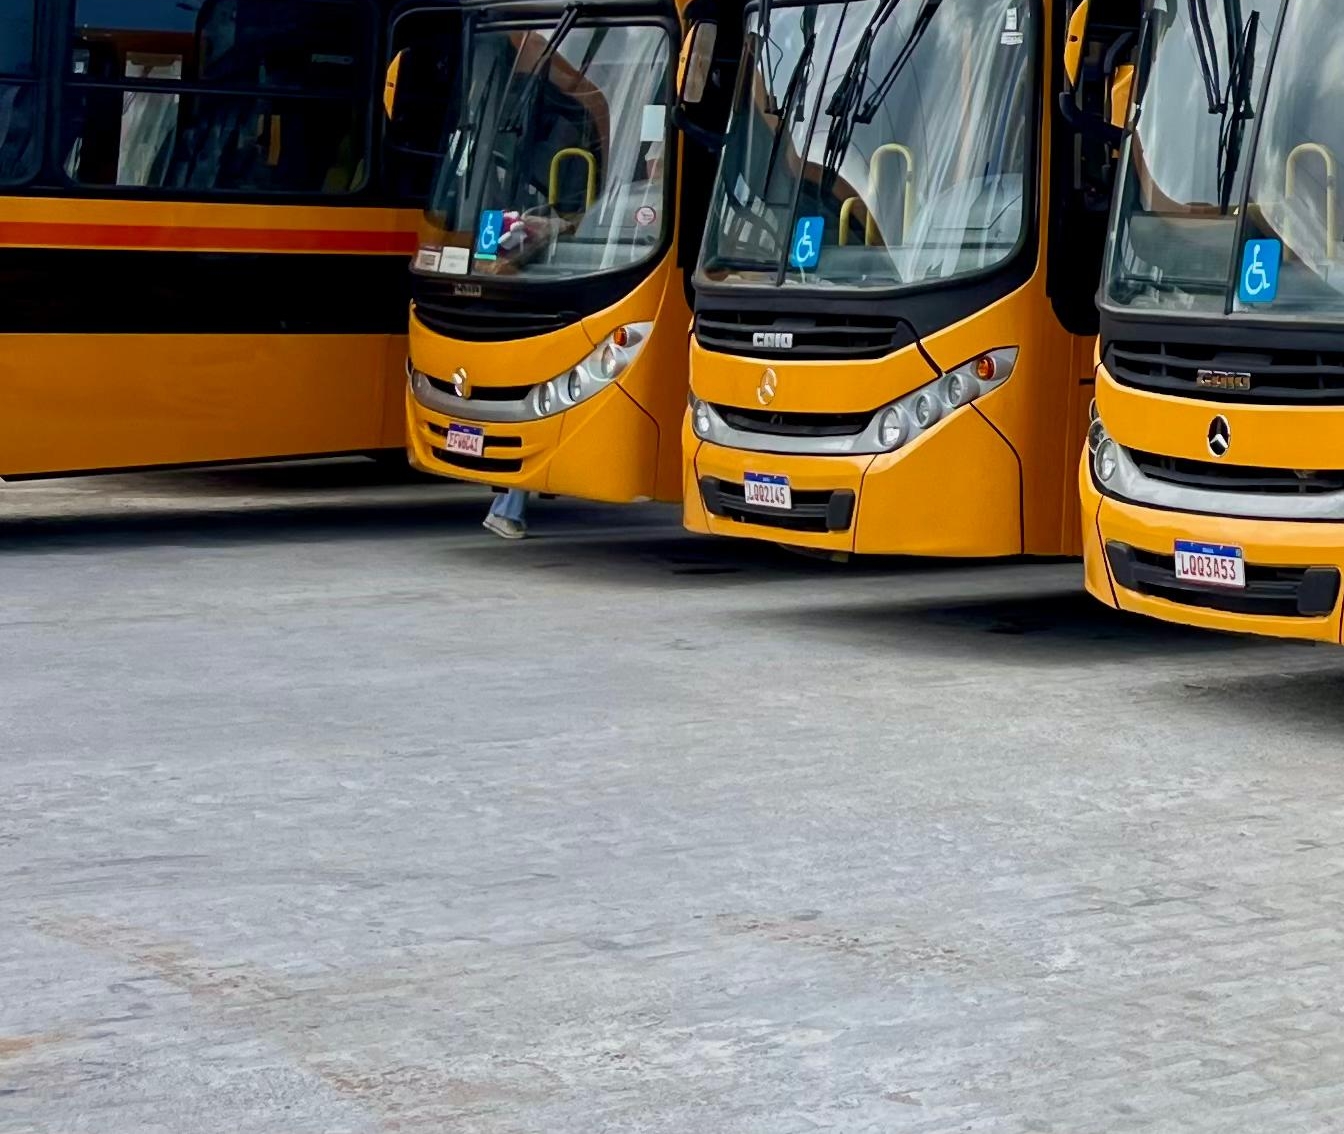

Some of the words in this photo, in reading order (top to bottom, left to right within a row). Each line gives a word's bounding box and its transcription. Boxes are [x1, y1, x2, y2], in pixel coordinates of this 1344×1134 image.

[752, 332, 793, 348] CAIO
[1197, 369, 1251, 391] CAIO
[1181, 553, 1236, 581] LQQ3A53
